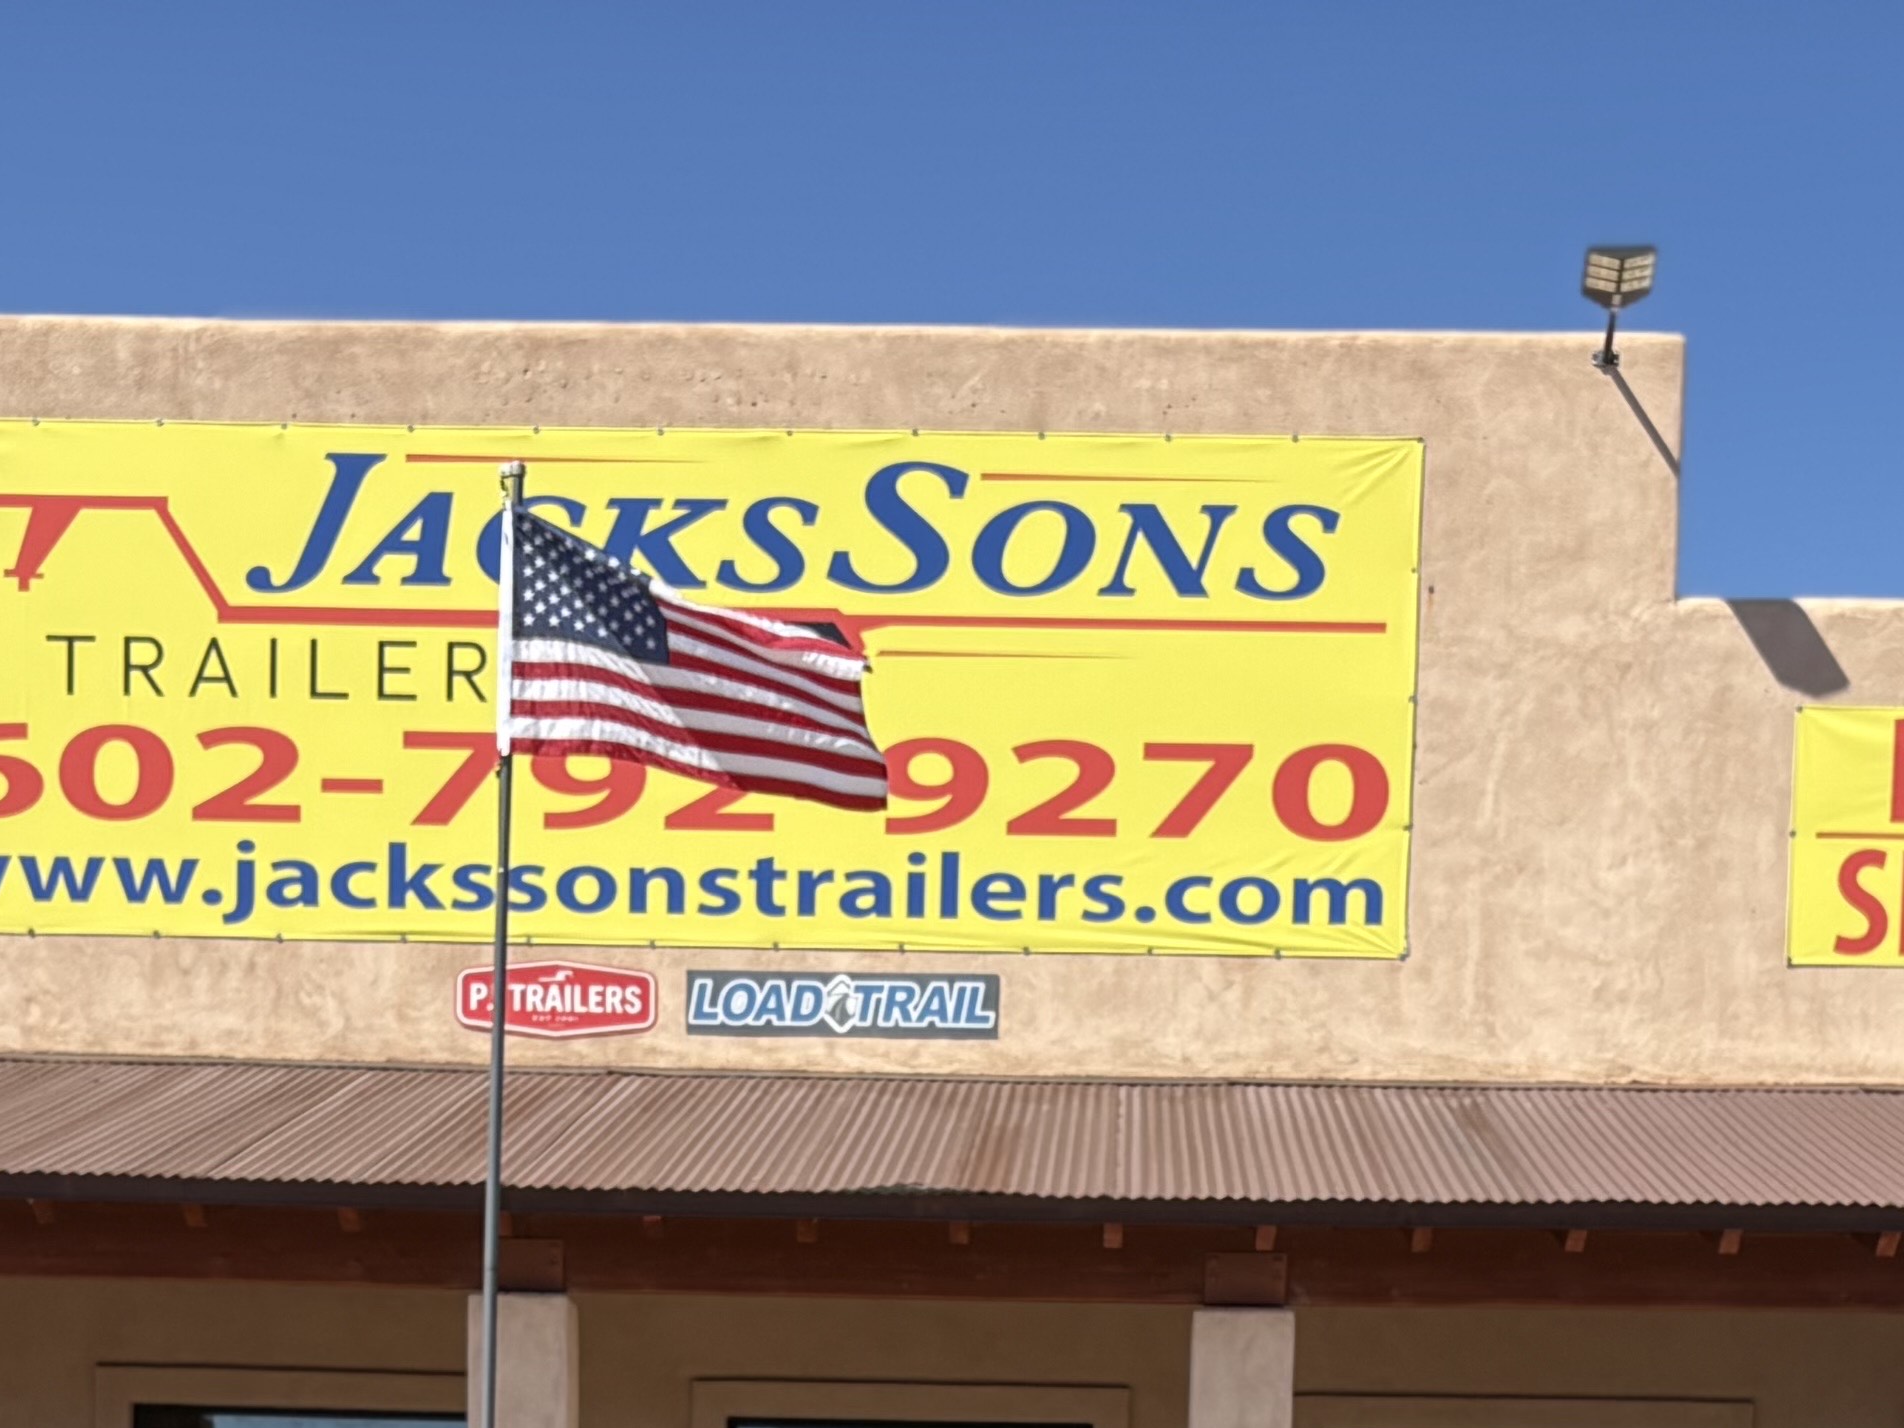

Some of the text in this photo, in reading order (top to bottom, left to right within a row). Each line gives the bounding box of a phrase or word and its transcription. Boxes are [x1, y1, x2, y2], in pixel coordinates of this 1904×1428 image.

[469, 982, 643, 1015] P TRAILERS
[691, 980, 995, 1028] LOAD TRAIL
